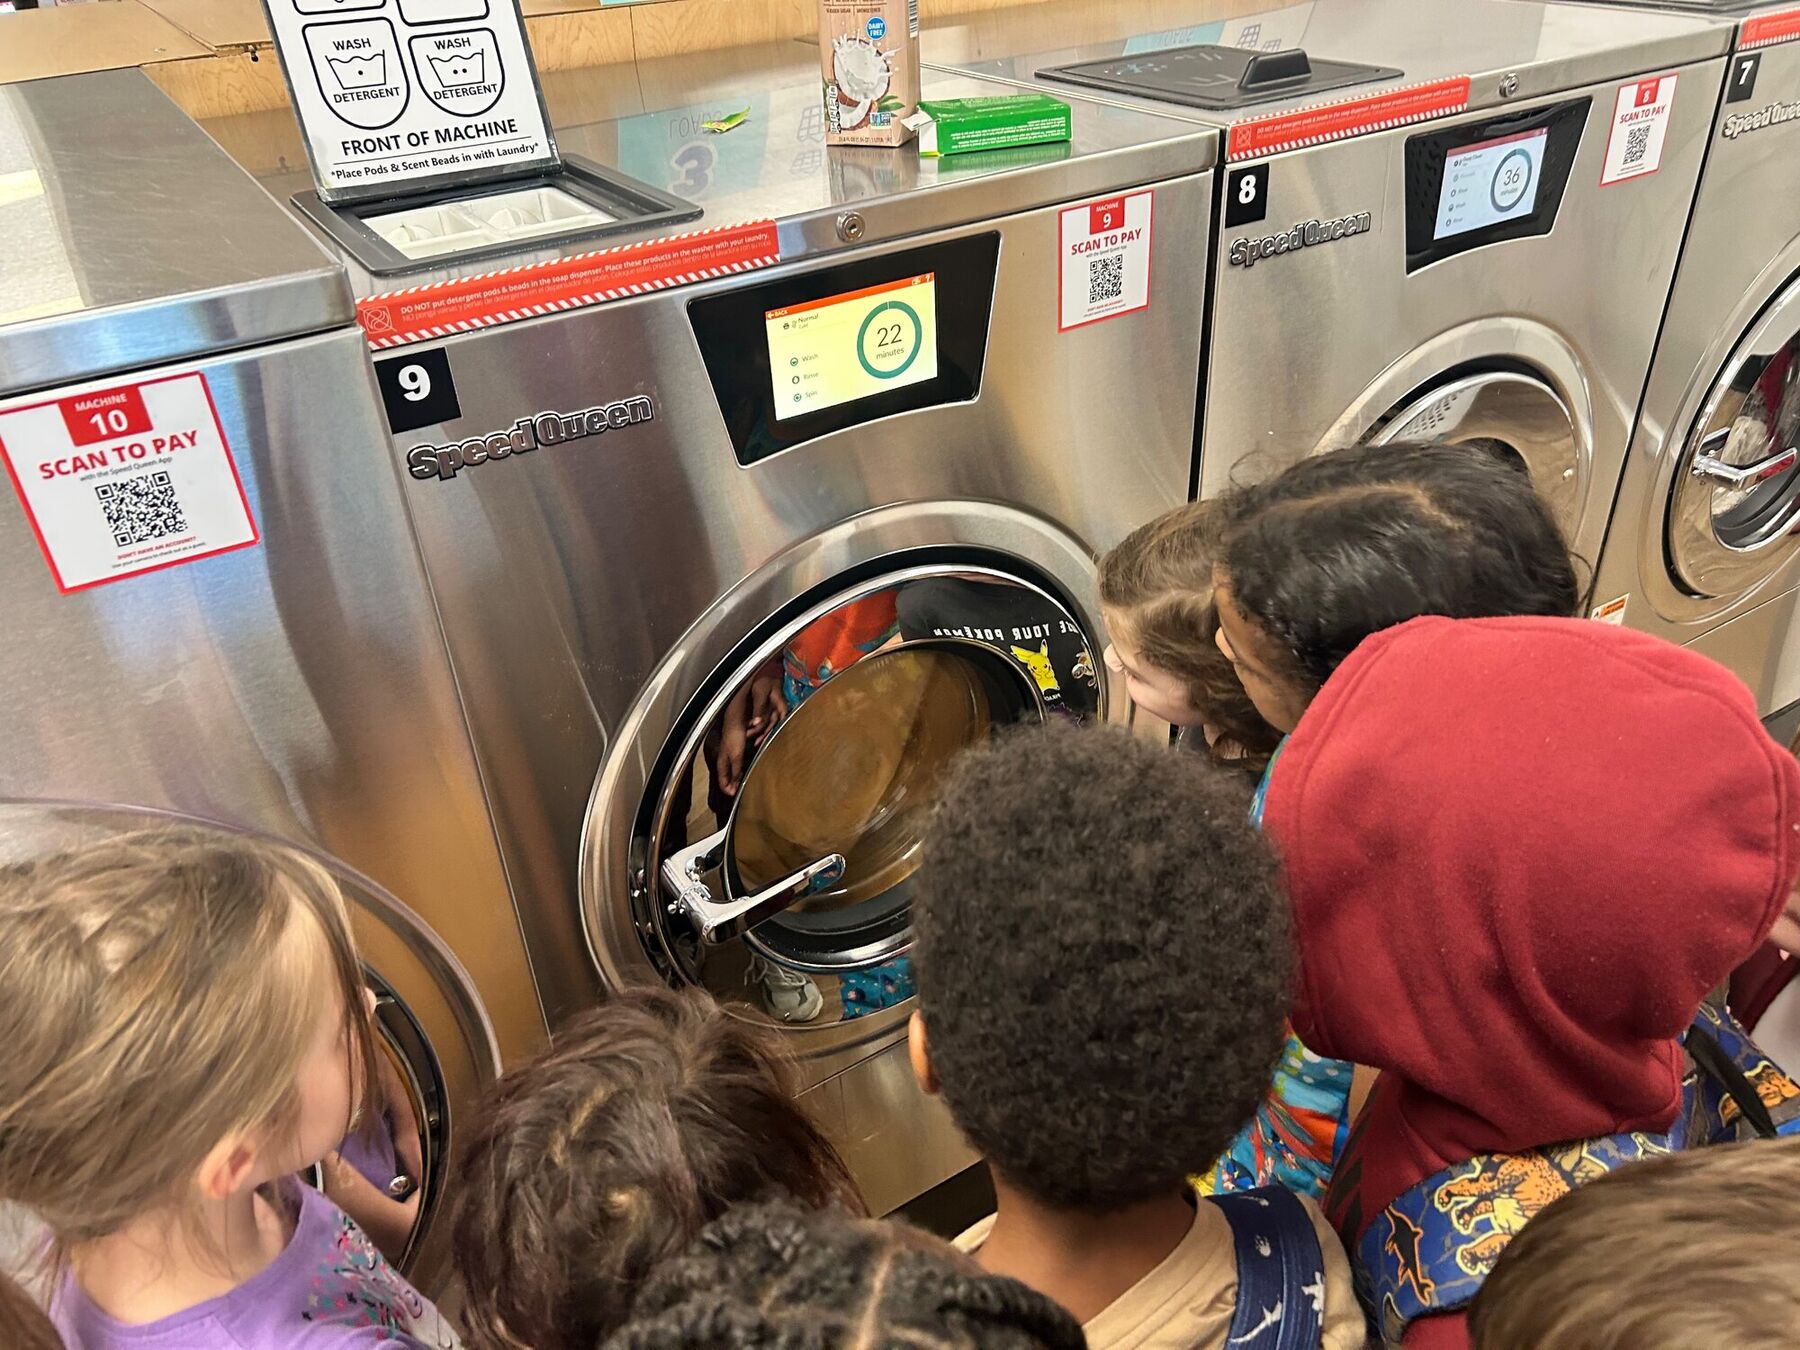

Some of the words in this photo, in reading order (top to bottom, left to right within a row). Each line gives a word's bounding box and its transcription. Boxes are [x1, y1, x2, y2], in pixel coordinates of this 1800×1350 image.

[868, 22, 884, 30] DAIRY
[869, 29, 883, 37] FREE
[333, 38, 372, 51] WASH
[434, 37, 471, 50] WASH
[1738, 59, 1754, 86] 7
[333, 86, 401, 104] DETERGENT
[433, 83, 499, 101] DETERGENT
[1642, 90, 1651, 103] 8
[1619, 111, 1639, 124] SCAN
[1641, 108, 1651, 119] TO
[1651, 104, 1667, 116] PAY
[1721, 106, 1772, 140] Speed
[341, 134, 402, 156] FRONT
[407, 131, 431, 147] OF
[434, 118, 519, 144] MACHINE
[364, 164, 389, 175] Pods
[391, 162, 400, 172] &
[402, 157, 430, 171] Scent
[431, 154, 461, 167] Beads
[462, 152, 472, 162] in
[473, 149, 495, 160] with
[1503, 167, 1521, 186] 36
[1238, 174, 1257, 204] 8
[1096, 201, 1119, 213] MACHINE
[1102, 212, 1112, 229] 9
[1071, 238, 1101, 256] SCAN
[1103, 234, 1118, 248] TO
[1120, 228, 1143, 244] PAY
[1230, 224, 1304, 268] Speed
[1302, 211, 1372, 246] Queen
[400, 305, 413, 315] DO
[414, 302, 431, 312] NOT
[432, 299, 446, 309] put
[446, 291, 483, 305] detergent
[483, 288, 501, 298] pods
[508, 281, 530, 292] beads
[531, 279, 539, 287] in
[539, 277, 551, 286] the
[552, 273, 569, 283] soap
[569, 266, 605, 280] dispenser.
[605, 263, 623, 273] Place
[623, 259, 642, 269] these
[642, 253, 672, 267] products
[672, 251, 680, 259] in
[680, 248, 691, 257] the
[691, 243, 715, 255] washer
[715, 239, 729, 249] with
[729, 238, 745, 248] your
[744, 232, 769, 244] laundry.
[797, 313, 819, 324] Normal
[876, 323, 903, 348] 22
[802, 353, 819, 364] Wash
[876, 347, 905, 360] minutes
[397, 364, 432, 402] 9
[75, 393, 128, 412] MACHINE
[89, 409, 129, 437] 10
[407, 418, 537, 481] Speed
[535, 394, 654, 448] Queen
[38, 450, 109, 480] SCAN
[112, 442, 147, 464] TO
[152, 430, 198, 455] PAY
[80, 472, 96, 481] with
[97, 470, 109, 478] the
[109, 464, 133, 476] Speed
[133, 459, 158, 470] Queen
[158, 456, 173, 465] App
